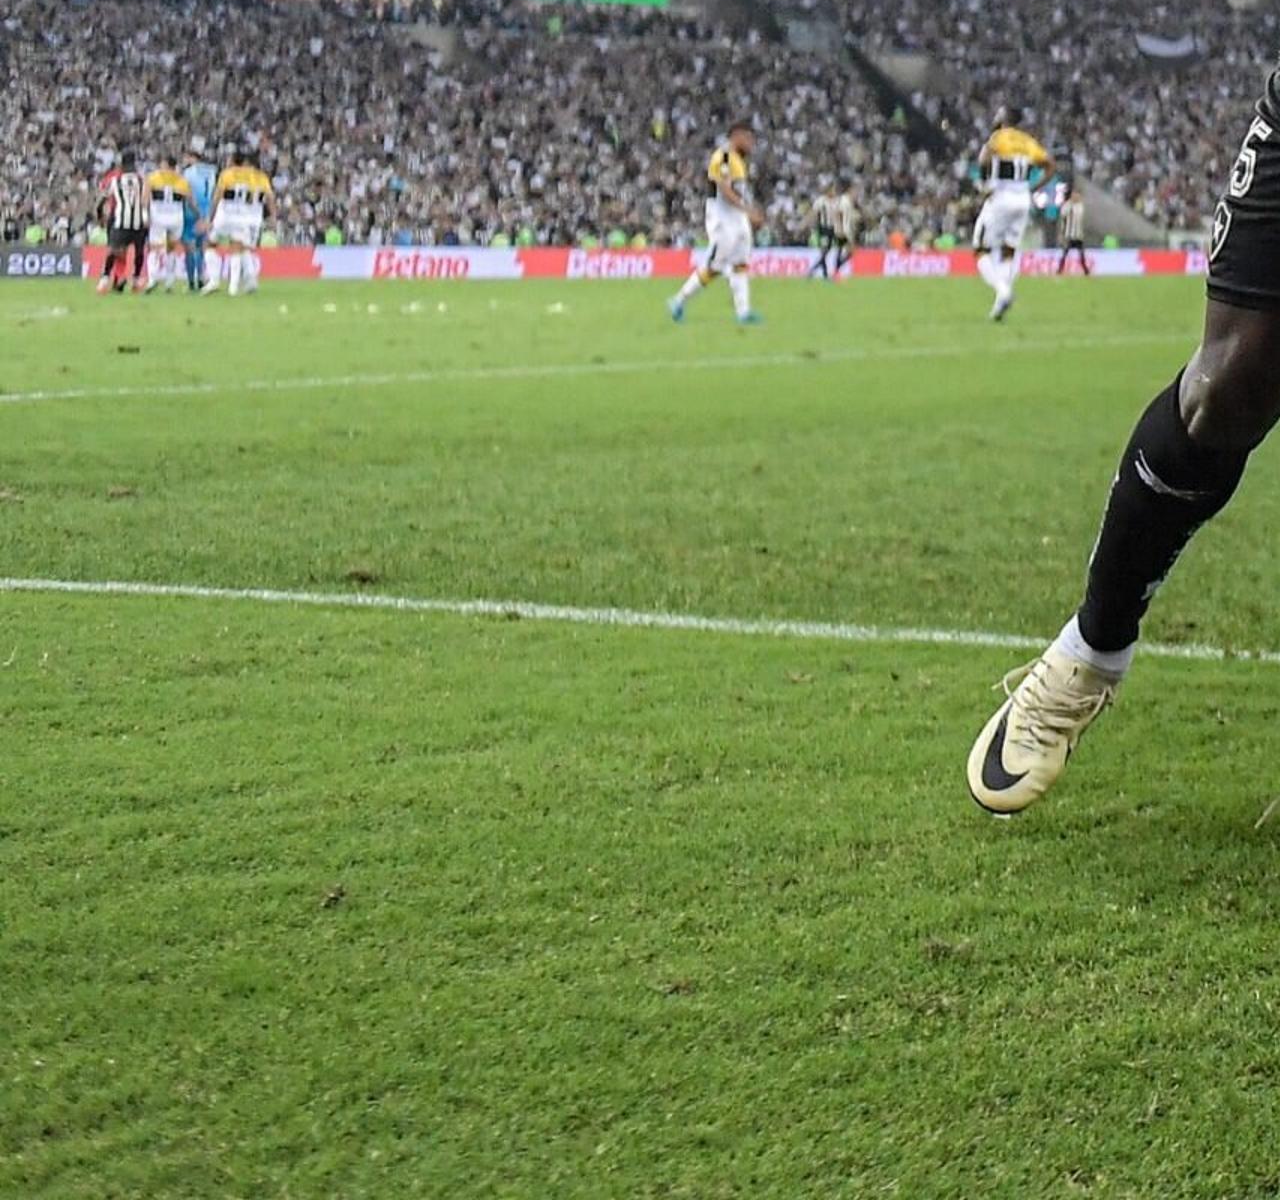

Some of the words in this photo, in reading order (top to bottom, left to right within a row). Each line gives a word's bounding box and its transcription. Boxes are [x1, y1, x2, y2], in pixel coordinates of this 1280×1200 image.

[7, 253, 73, 275] 2024
[373, 249, 469, 278] Betano
[567, 249, 654, 277] Betano
